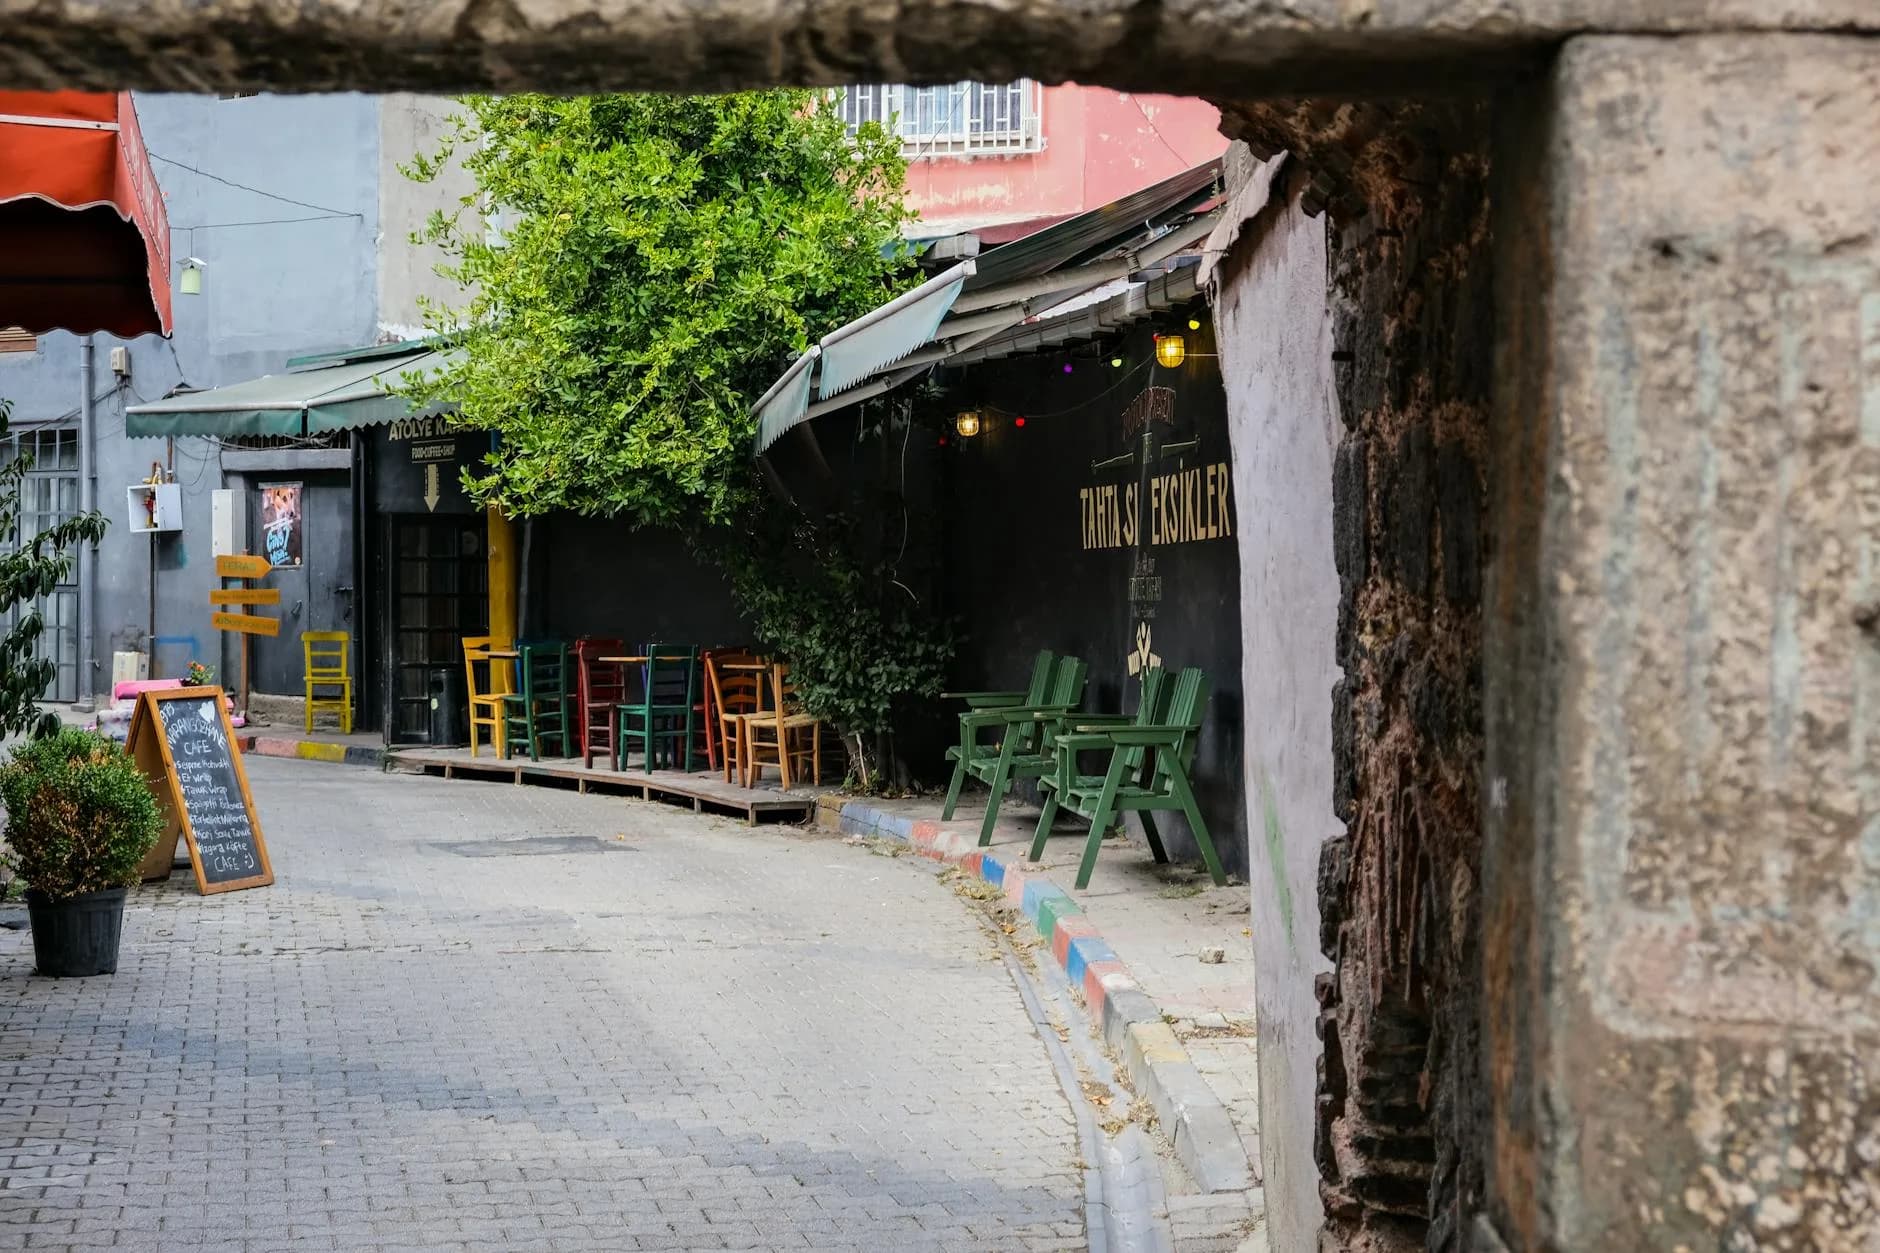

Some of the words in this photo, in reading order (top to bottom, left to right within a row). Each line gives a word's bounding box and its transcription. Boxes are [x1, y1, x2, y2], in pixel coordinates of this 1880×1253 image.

[1080, 484, 1121, 550] TAHTA
[1151, 457, 1231, 545] EKSİKLER
[183, 740, 212, 756] CAFE
[214, 855, 239, 872] CAFE
